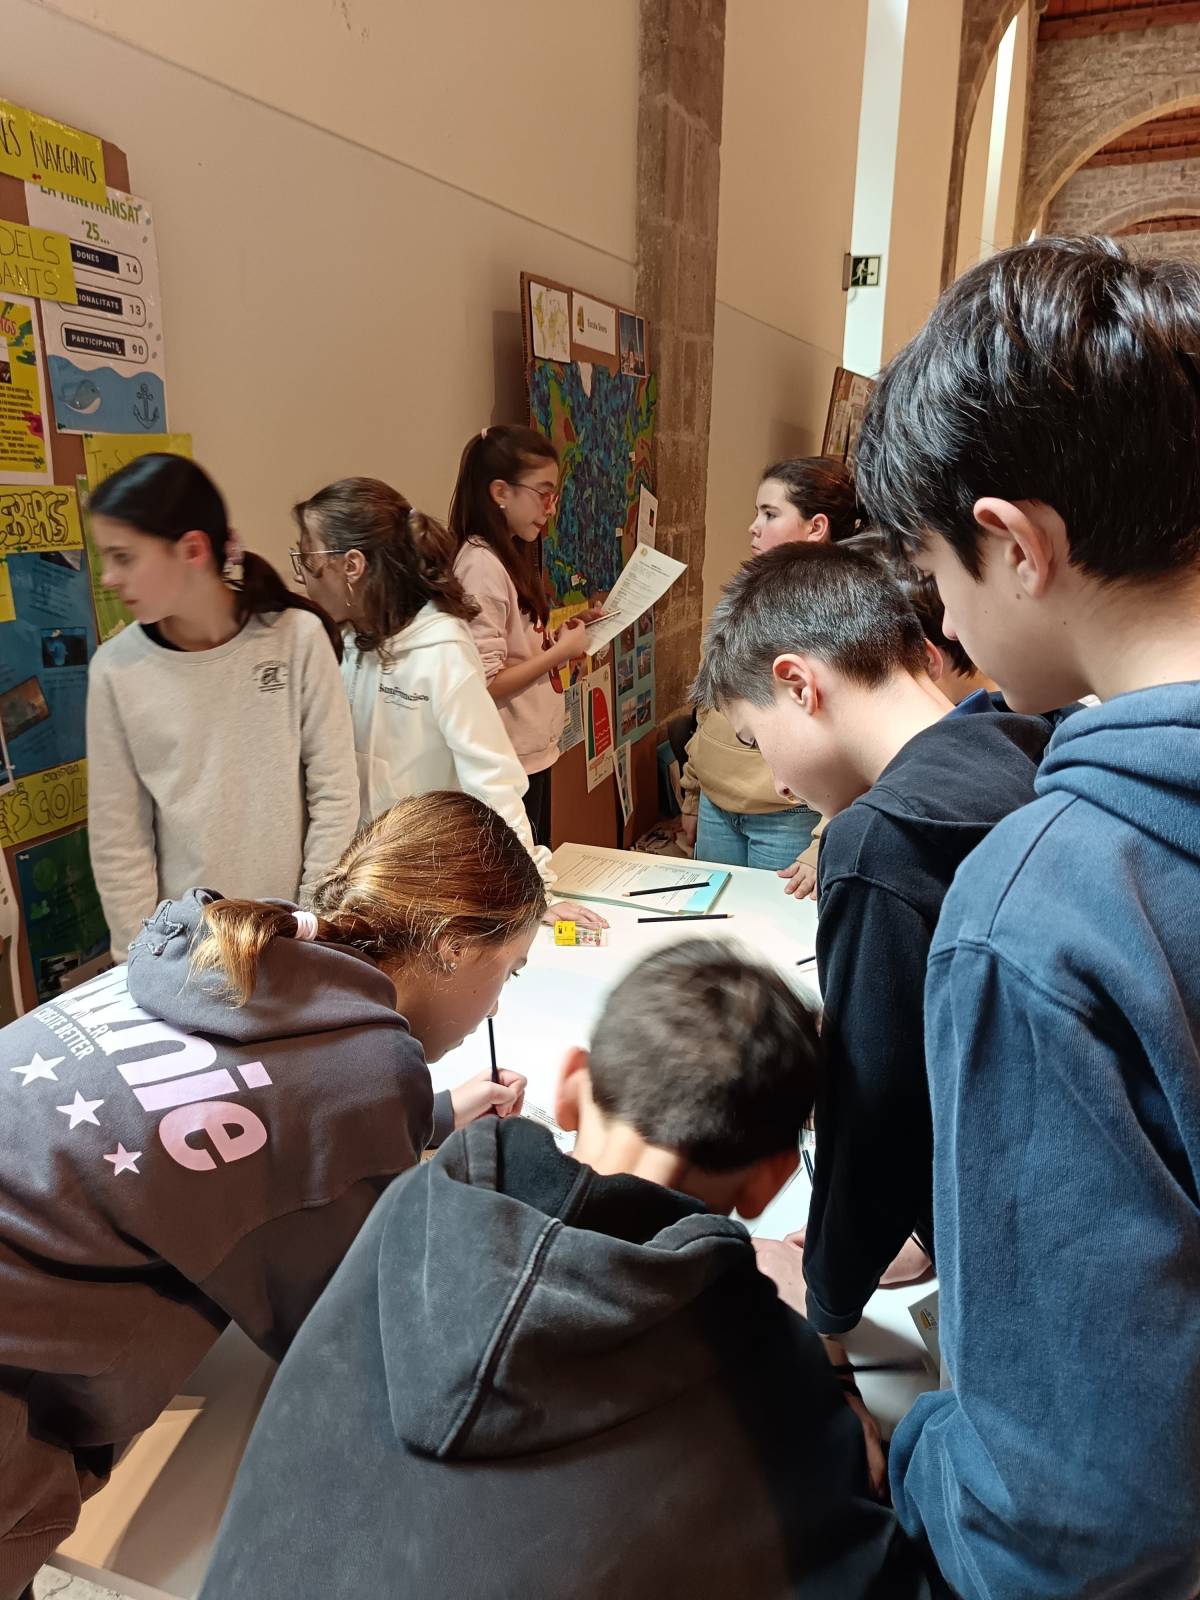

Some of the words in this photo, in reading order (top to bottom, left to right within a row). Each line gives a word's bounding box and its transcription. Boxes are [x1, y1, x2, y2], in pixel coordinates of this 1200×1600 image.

[0, 118, 22, 157] ES
[30, 130, 97, 184] NAVEGANTS
[76, 250, 100, 263] DONES
[126, 262, 138, 275] 14
[0, 262, 58, 296] ANTS
[77, 292, 120, 310] IONALITATS
[129, 304, 142, 315] 13
[71, 333, 120, 350] PARTICIPANTS
[132, 344, 144, 355] 90
[54, 1022, 95, 1060] BETTER
